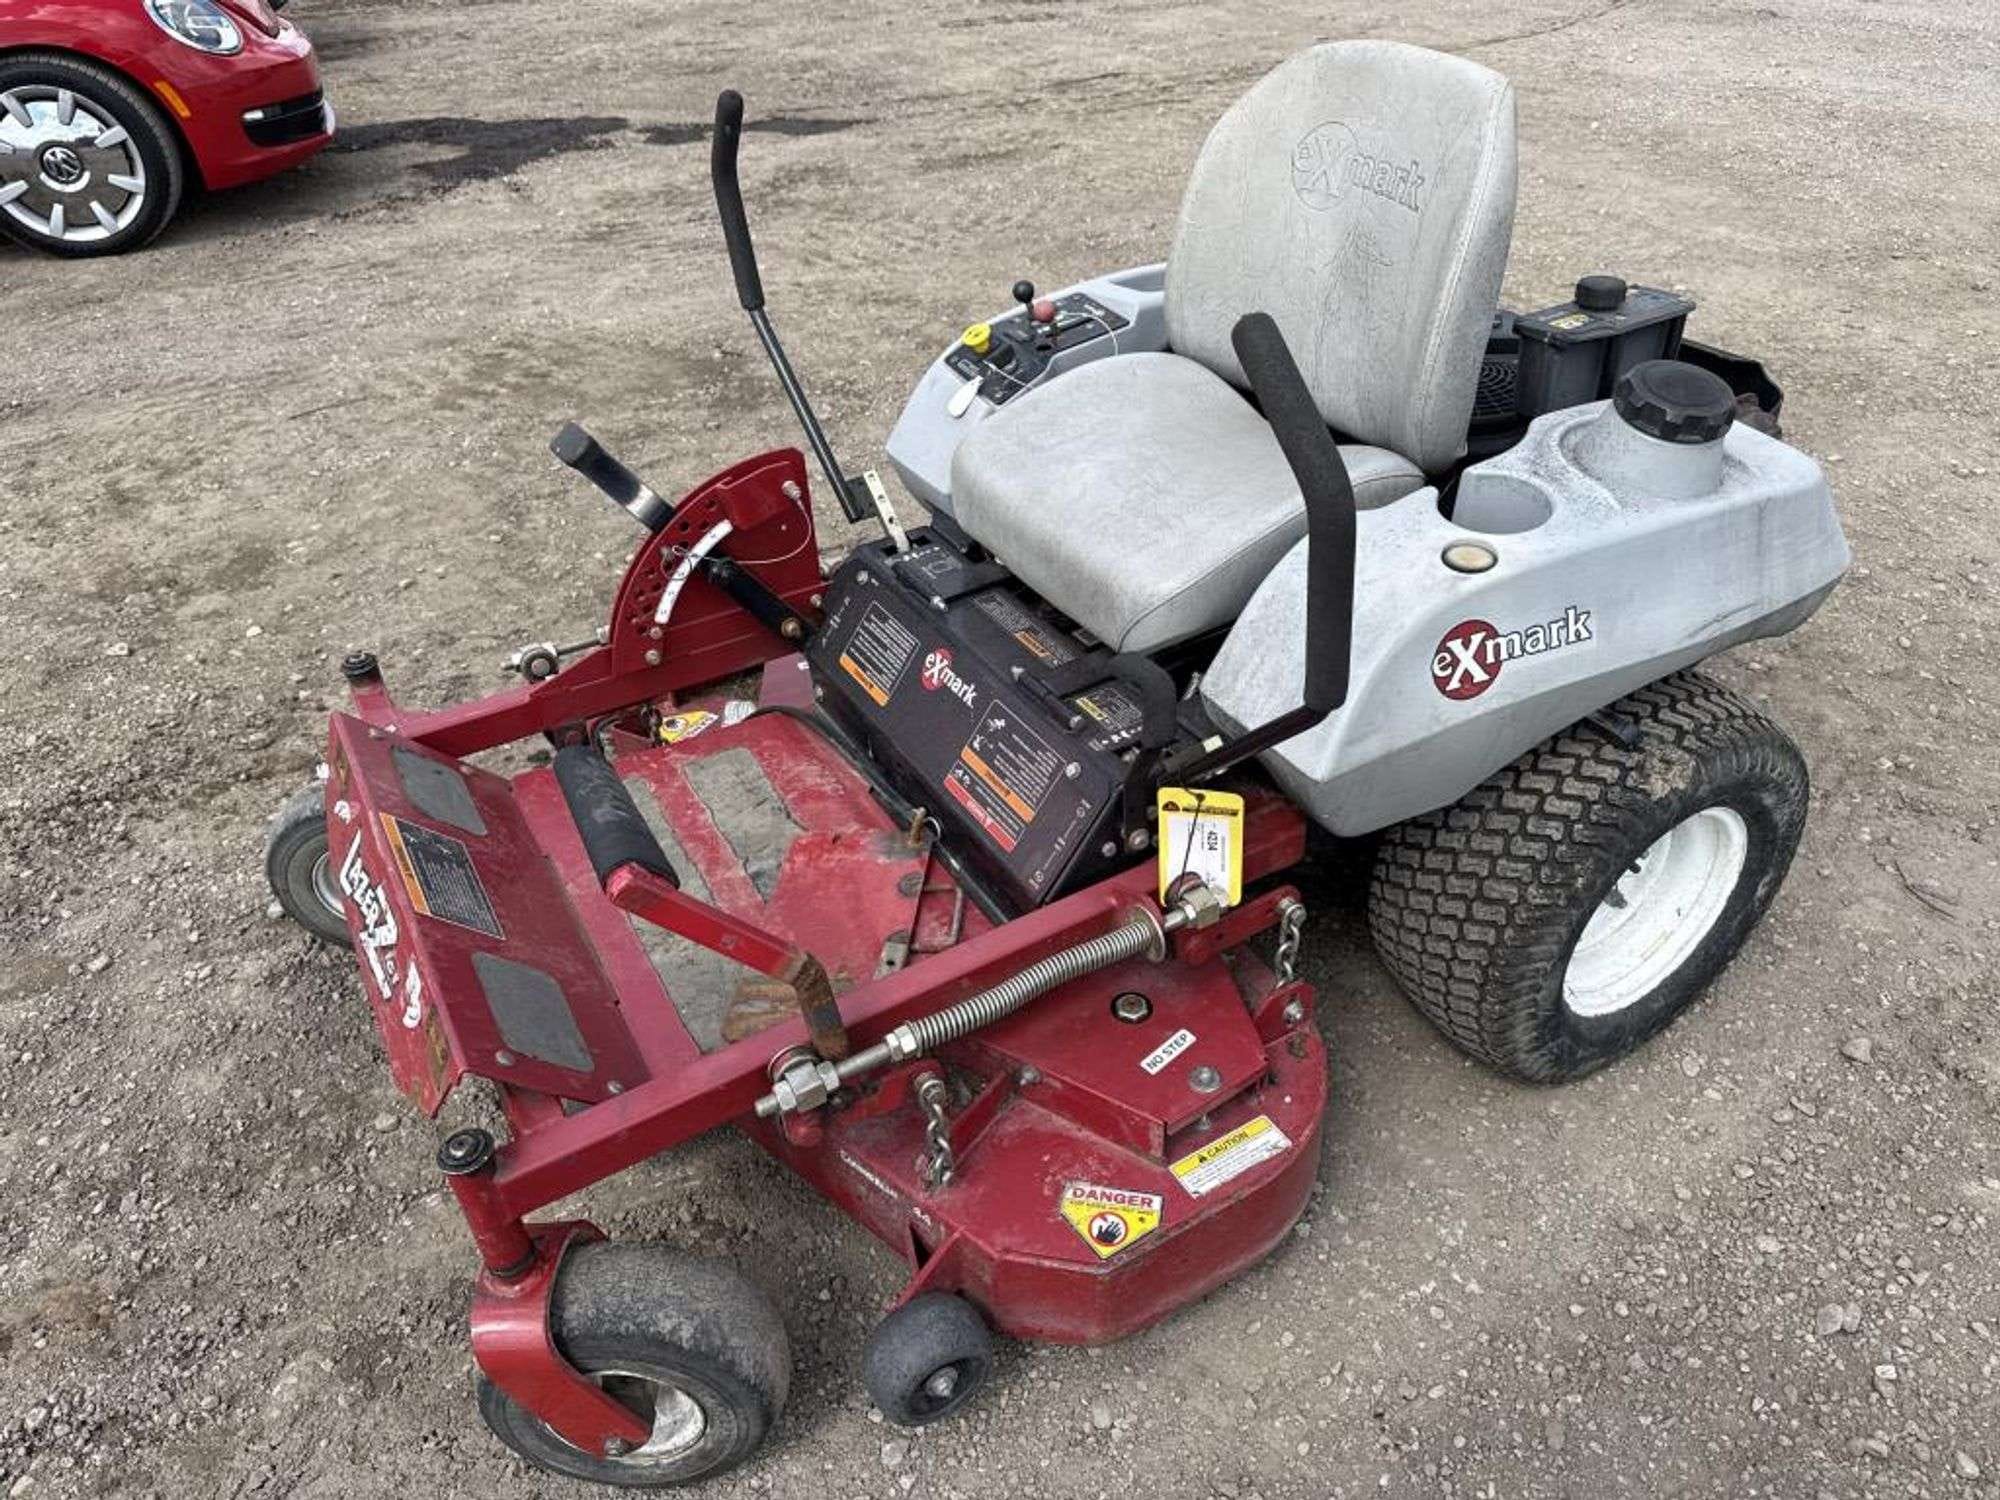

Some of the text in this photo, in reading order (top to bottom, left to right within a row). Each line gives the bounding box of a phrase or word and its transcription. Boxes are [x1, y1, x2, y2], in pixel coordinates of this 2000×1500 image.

[1432, 606, 1592, 691] eXmark
[923, 652, 977, 709] eXmark
[1146, 1033, 1188, 1070] NO STEP
[1207, 1130, 1251, 1158] CAUTION
[1071, 1187, 1154, 1208] DANGER
